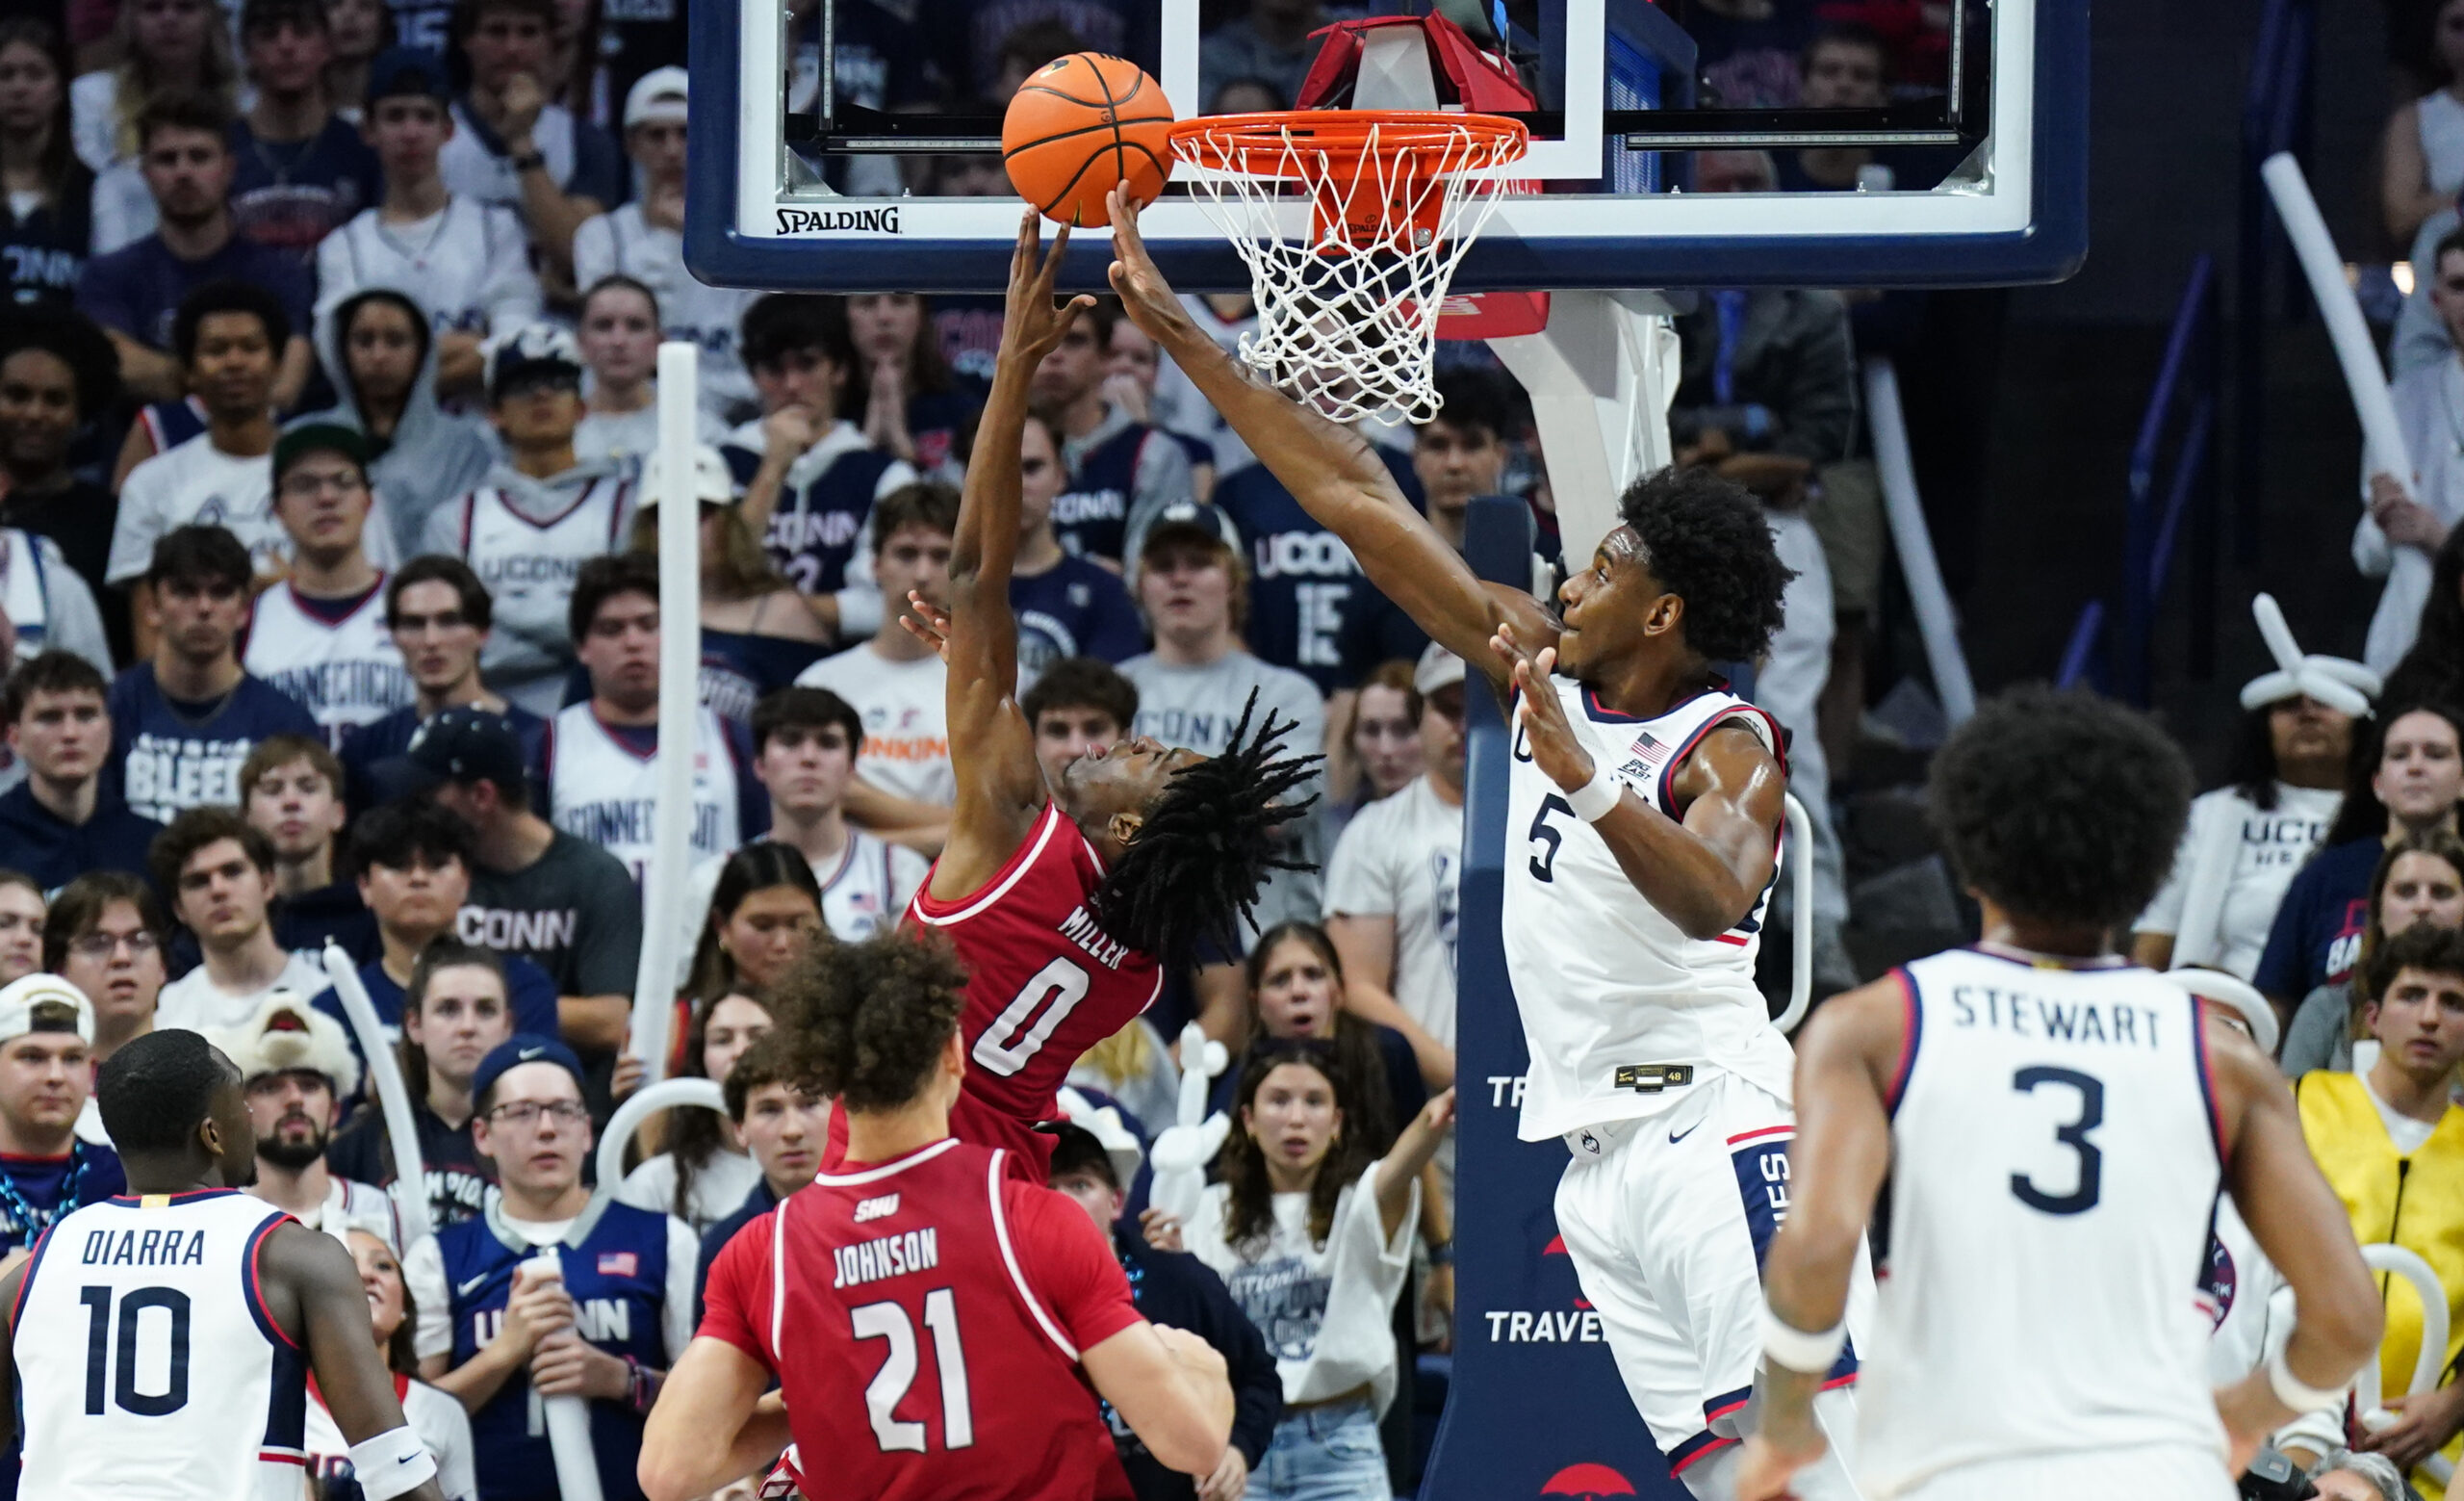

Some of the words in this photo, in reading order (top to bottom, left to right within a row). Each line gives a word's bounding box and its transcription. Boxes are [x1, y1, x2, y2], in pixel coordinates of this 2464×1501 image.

[776, 206, 899, 235] SPALDING
[1621, 764, 1652, 781] EAST
[1629, 759, 1652, 771] BIG
[1528, 792, 1578, 883] 5
[457, 905, 575, 950] CONN
[1059, 906, 1129, 970] MILLER
[972, 956, 1090, 1076] 0
[1954, 985, 2161, 1049] STEWART
[2010, 1066, 2104, 1215] 3
[853, 1192, 899, 1223] SHU
[83, 1229, 203, 1265] DIARRA
[834, 1227, 937, 1290] JOHNSON
[80, 1285, 191, 1415] 10
[475, 1298, 629, 1350] UNN
[1484, 1311, 1607, 1343] TRAVE
[851, 1287, 973, 1453] 21
